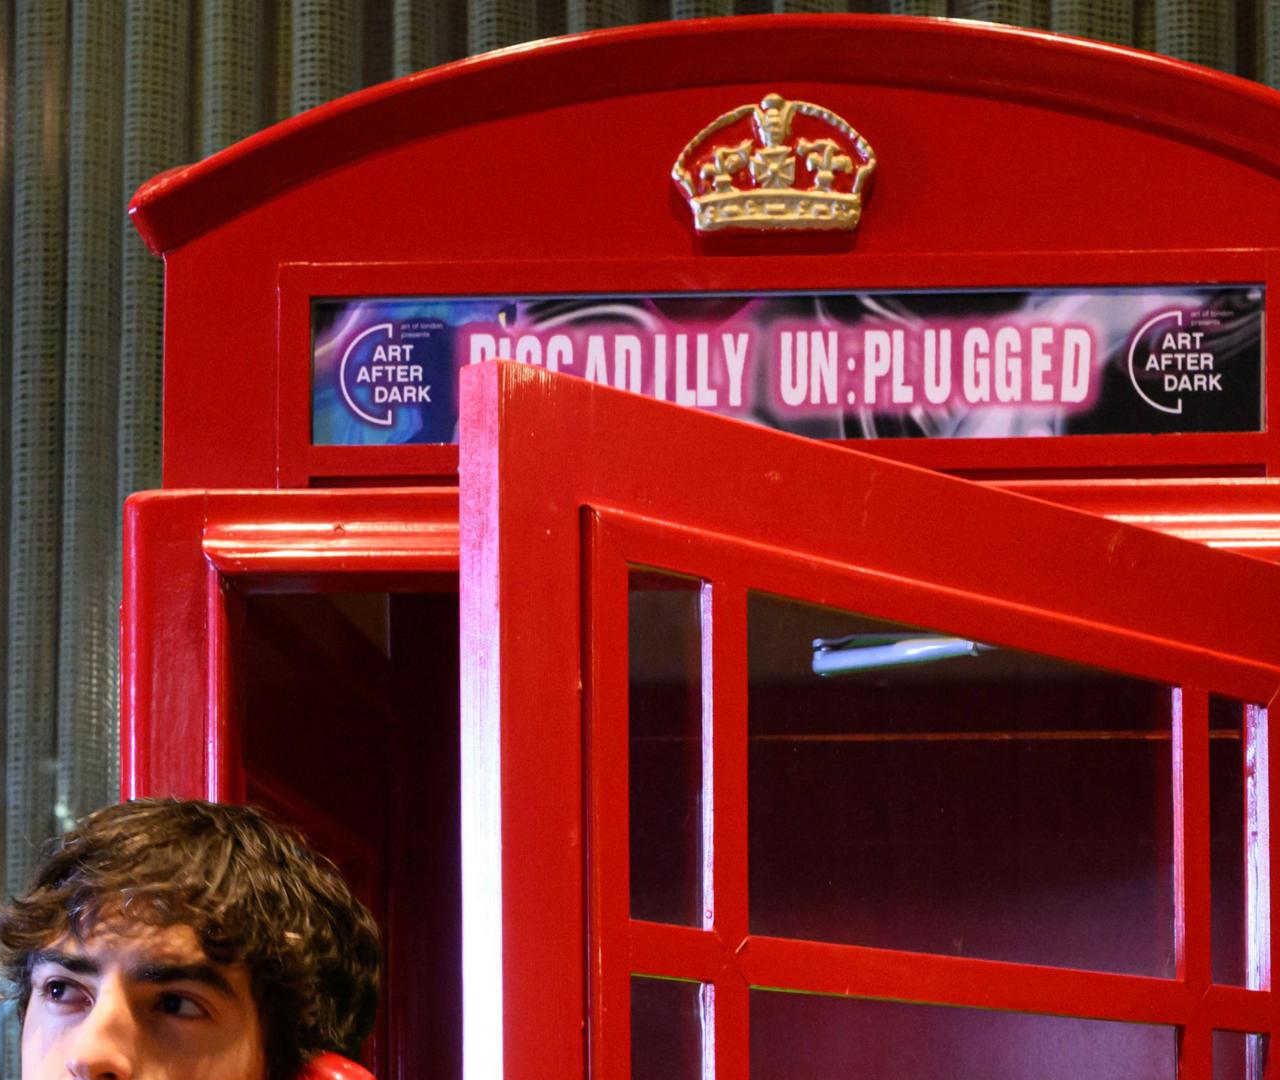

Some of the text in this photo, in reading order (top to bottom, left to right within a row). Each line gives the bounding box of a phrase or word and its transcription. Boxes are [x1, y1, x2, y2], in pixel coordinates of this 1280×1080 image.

[1162, 332, 1204, 350] ART
[372, 345, 414, 362] ART
[1145, 352, 1214, 371] AFTER
[356, 365, 424, 383] AFTER
[779, 326, 1092, 406] UN:PLUGGED
[1164, 373, 1223, 392] DARK
[374, 385, 431, 403] DARK
